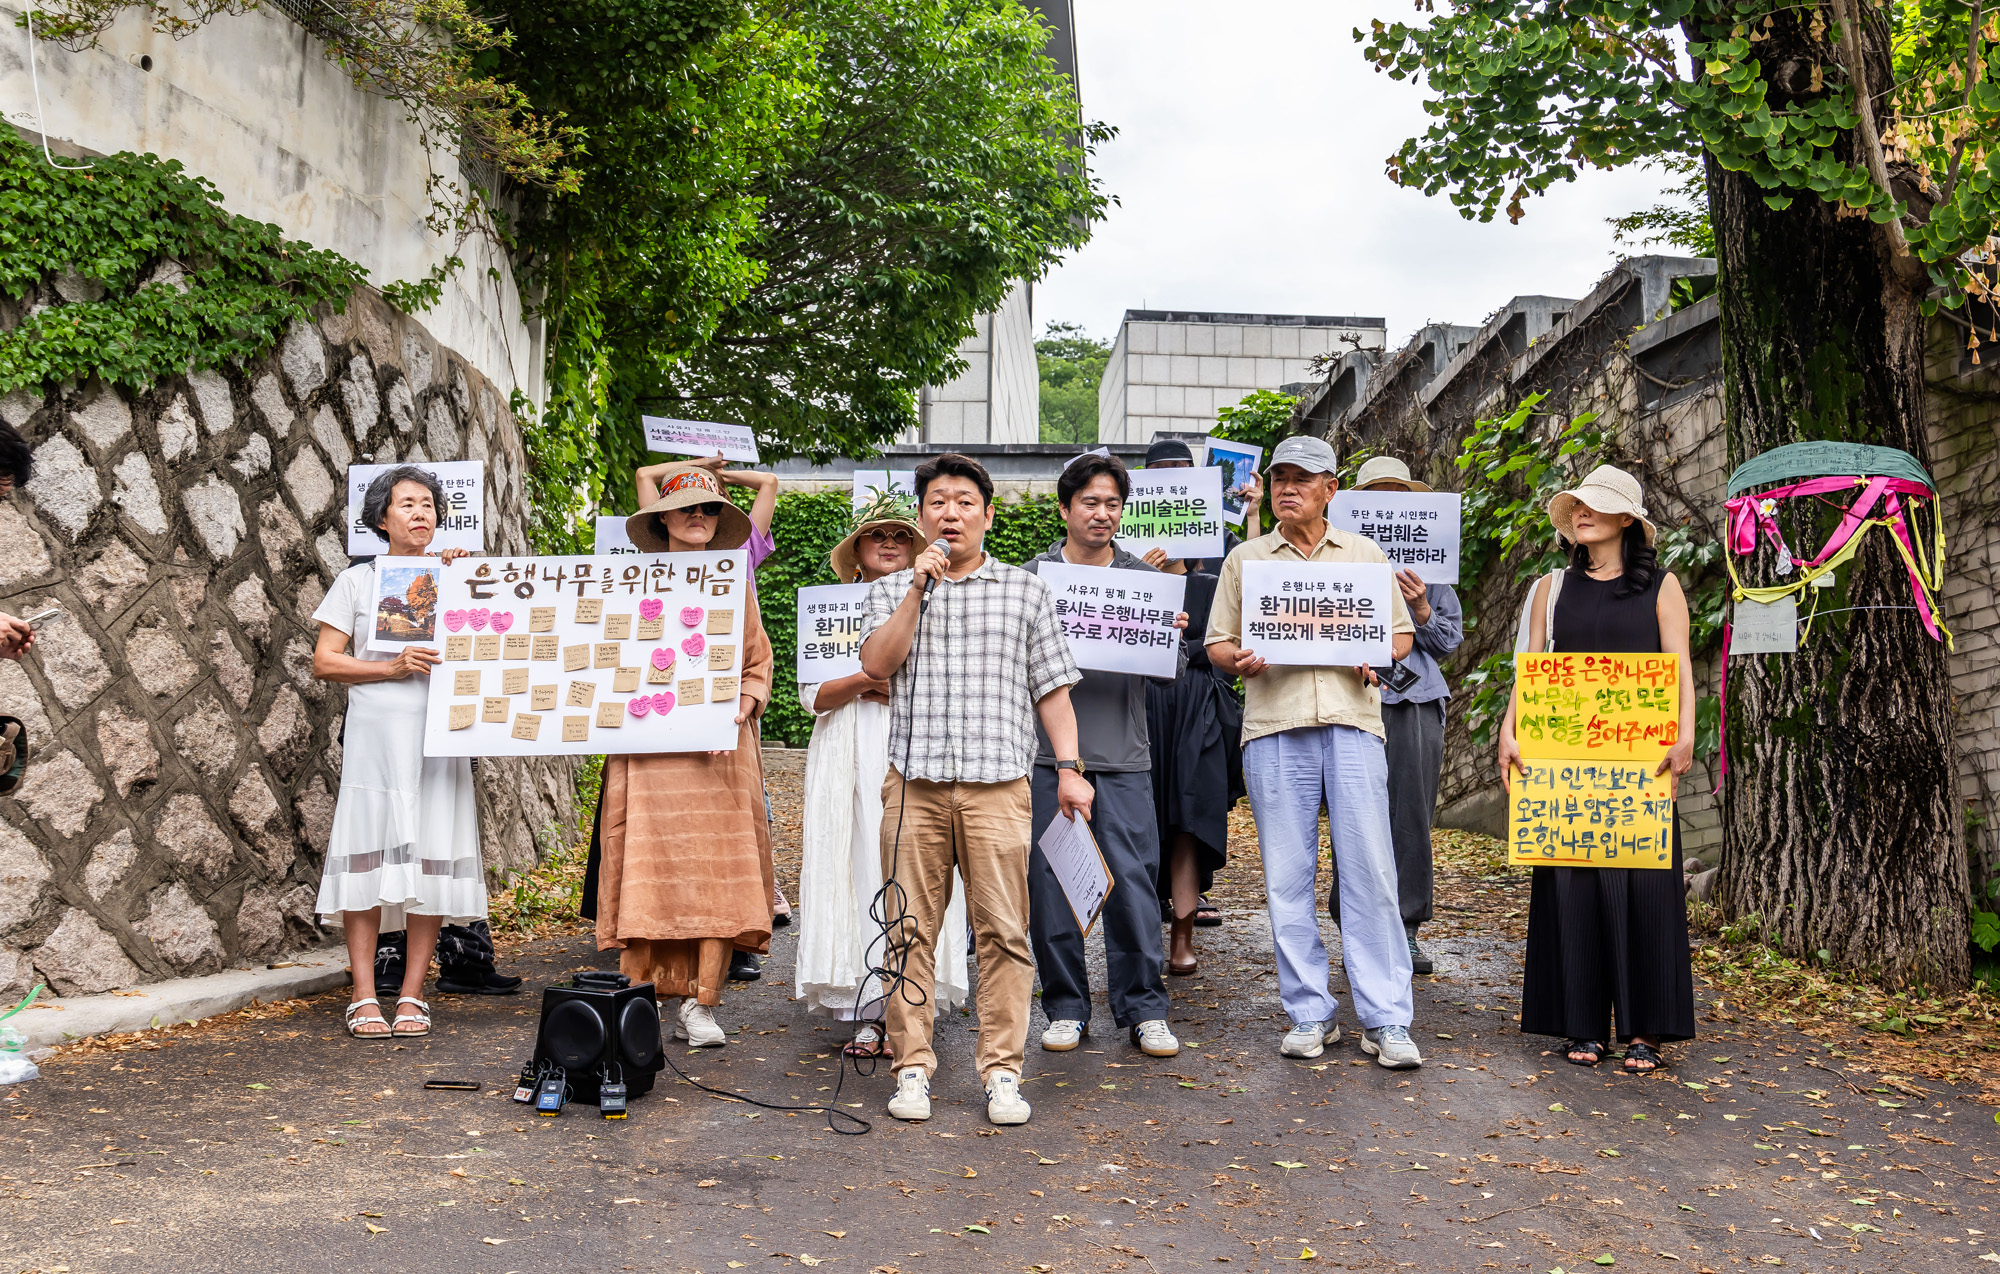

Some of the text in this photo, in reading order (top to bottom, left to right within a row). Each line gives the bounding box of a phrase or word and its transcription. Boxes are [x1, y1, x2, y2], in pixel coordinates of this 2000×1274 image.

[650, 428, 692, 438] 서울시는
[1169, 486, 1189, 496] 독살
[1121, 498, 1207, 518] 기미술관은
[1351, 509, 1438, 520] 무단 독살 시인했다
[1158, 521, 1219, 538] 사과하라
[1387, 548, 1447, 564] 처벌하라
[685, 559, 735, 597] 마음
[1282, 581, 1353, 593] 은행나무 독살
[1067, 585, 1153, 603] 사유지 핑계 그만
[807, 602, 849, 614] 생명파괴
[1101, 604, 1176, 627] 은행나무를
[1260, 595, 1375, 618] 환기미술관은
[1106, 627, 1174, 649] 지정하라
[1249, 622, 1386, 642] 책임있게 복원하라
[1522, 656, 1576, 687] 부암동
[1523, 687, 1589, 713] 나무와
[1637, 687, 1671, 712] 모든
[1520, 713, 1678, 752] 생명들 살아주세요
[1516, 766, 1554, 792] 우리
